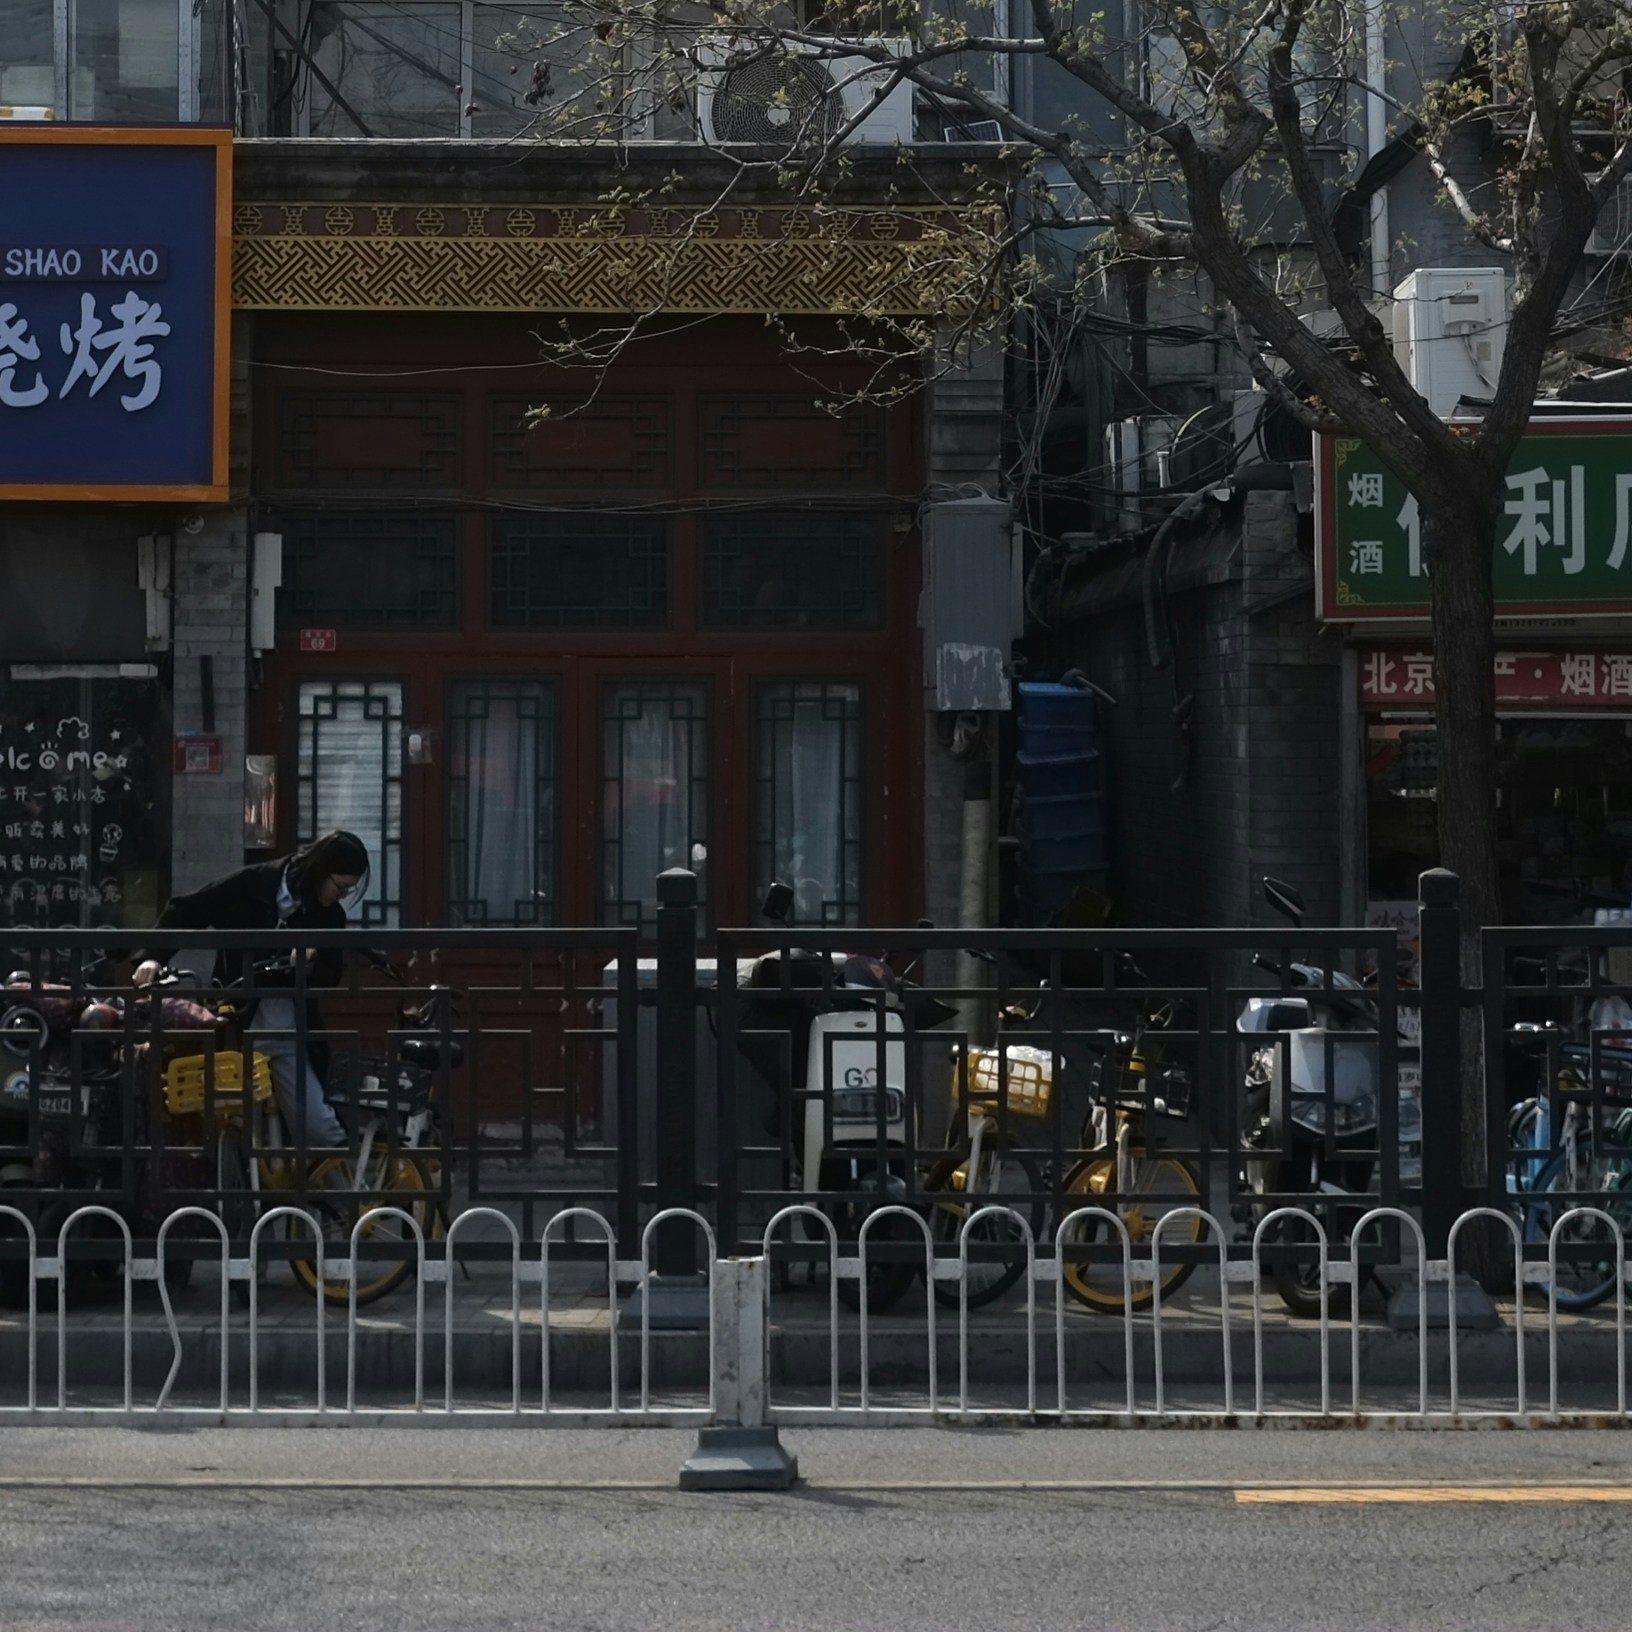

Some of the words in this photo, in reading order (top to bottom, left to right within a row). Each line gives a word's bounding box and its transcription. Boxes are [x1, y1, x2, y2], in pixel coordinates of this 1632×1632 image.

[5, 248, 82, 278] SHAO
[101, 248, 159, 278] KAO
[1348, 472, 1385, 575] 烟酒
[311, 638, 326, 649] 69
